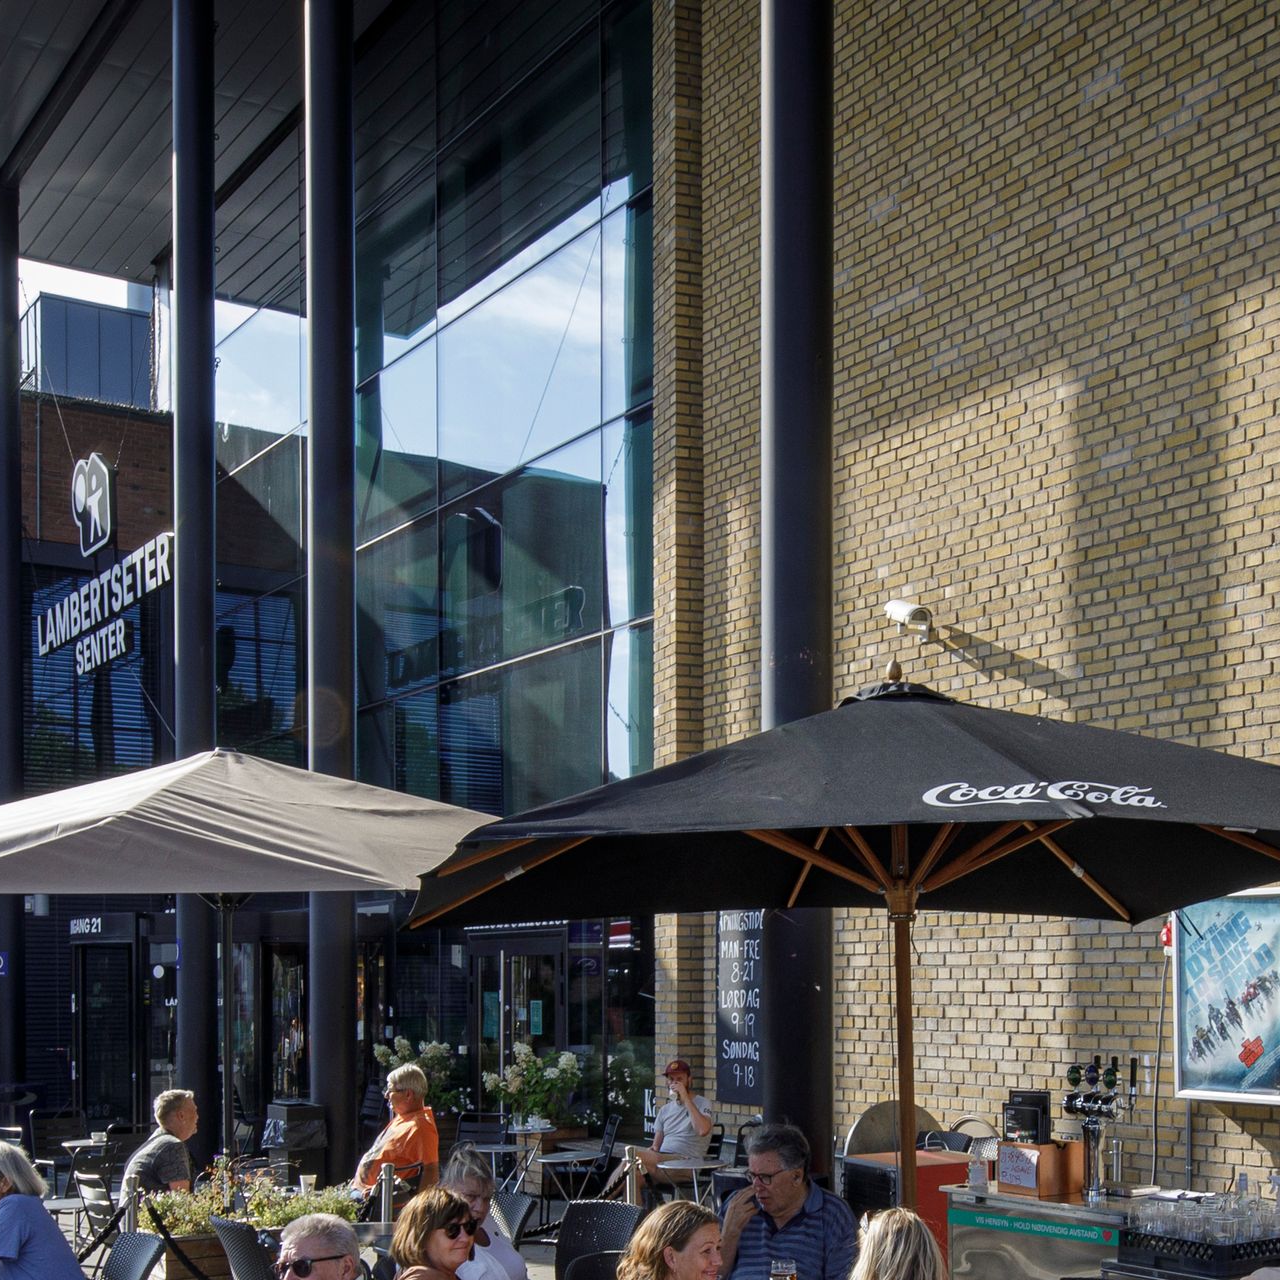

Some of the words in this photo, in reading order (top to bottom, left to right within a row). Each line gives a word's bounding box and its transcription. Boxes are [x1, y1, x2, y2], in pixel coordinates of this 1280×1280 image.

[37, 533, 171, 657] LAMBERTSETER
[75, 617, 126, 676] SENTER
[922, 780, 1163, 808] Coca-Cola
[91, 917, 102, 933] 21
[721, 939, 761, 960] MAN-FRE
[1186, 910, 1253, 980] DYING
[730, 961, 754, 983] 8-21
[721, 988, 760, 1010] LØRDAG
[731, 1012, 755, 1038] 9-19
[722, 1039, 760, 1063] SØNDAG
[732, 1063, 755, 1088] 9-18
[975, 1216, 985, 1224] VIS
[985, 1217, 1009, 1228] HENSYN
[1013, 1222, 1031, 1231] HOLD
[1031, 1223, 1069, 1236] NØDVENDIG
[1069, 1228, 1098, 1240] AVSTAND
